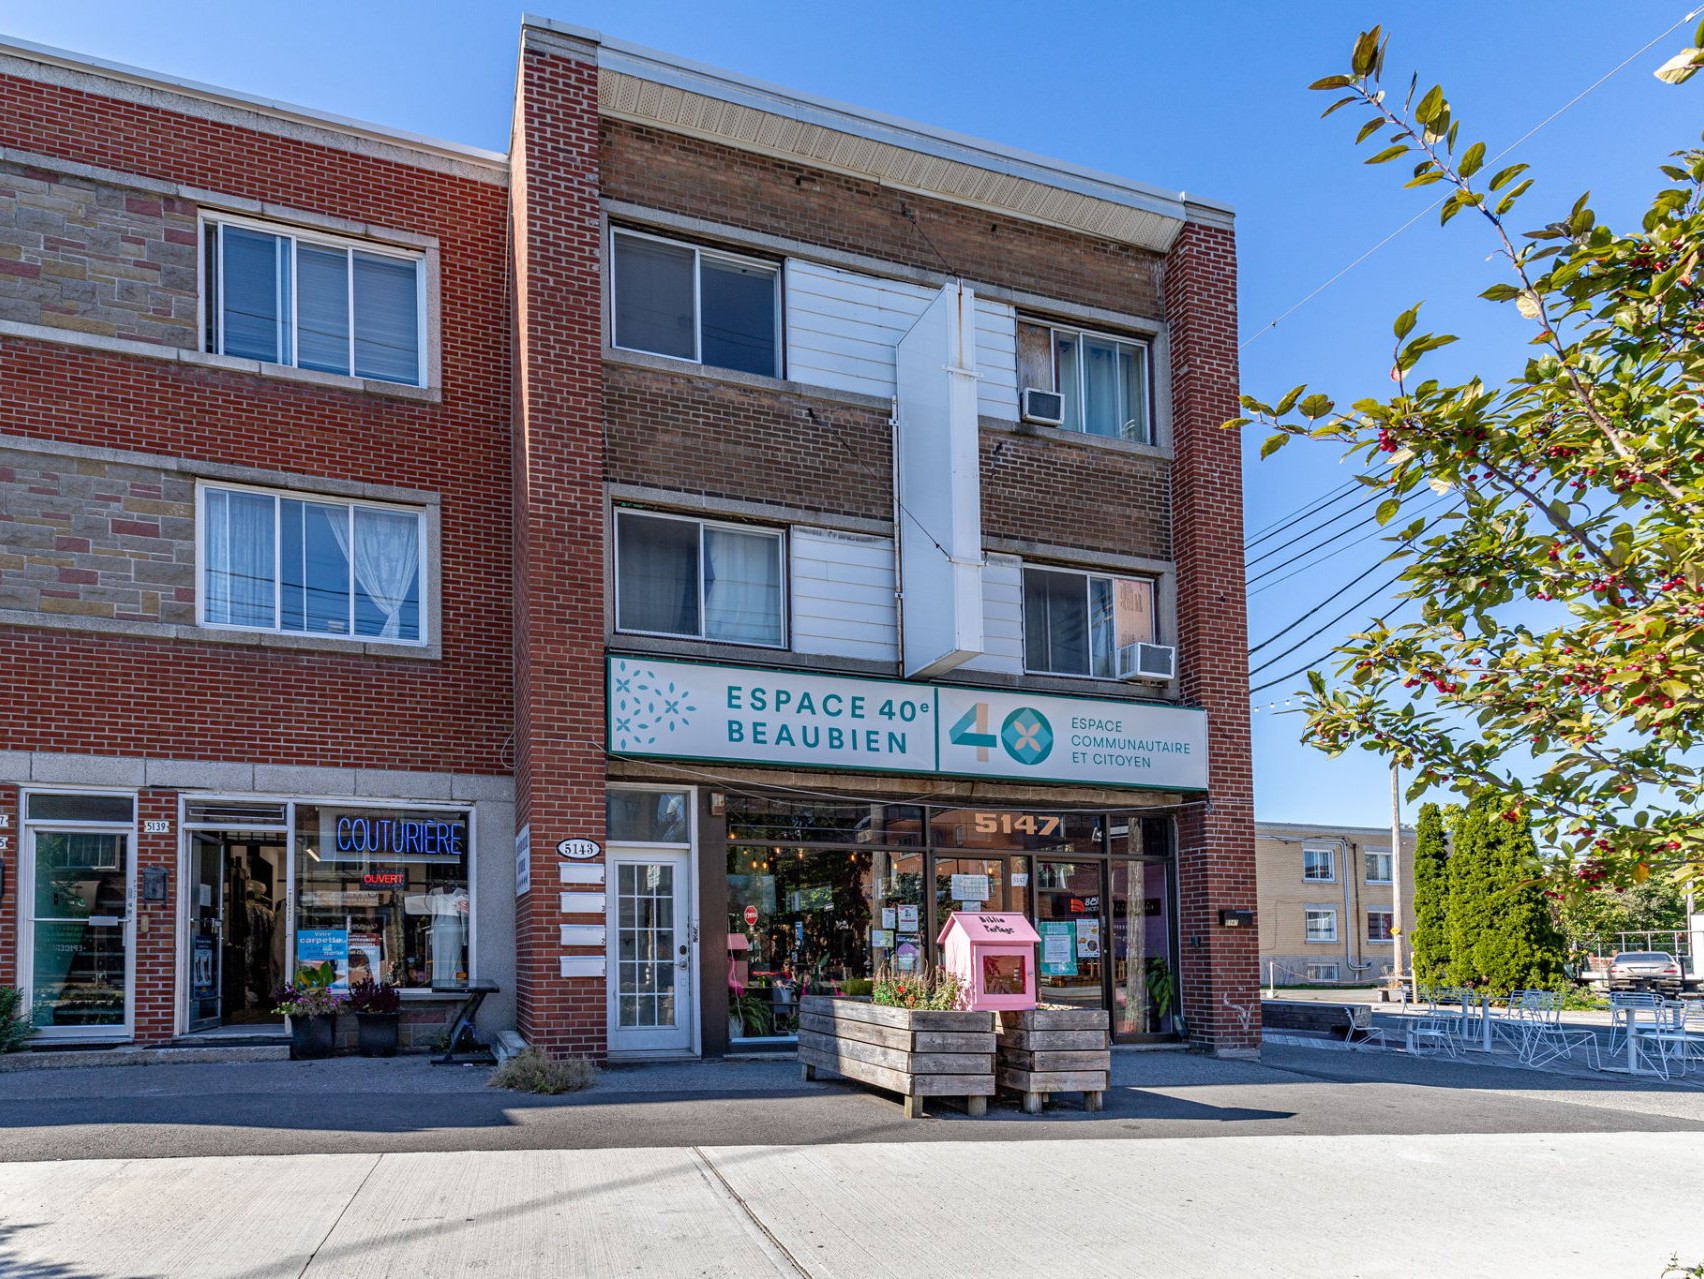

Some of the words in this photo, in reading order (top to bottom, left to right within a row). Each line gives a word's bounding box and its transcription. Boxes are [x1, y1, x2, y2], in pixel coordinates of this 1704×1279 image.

[727, 685, 865, 719] ESPACE
[1071, 717, 1122, 733] ESPACE
[727, 719, 907, 754] BEAUBIEN
[1071, 734, 1191, 754] COMMUNAUTAIRE
[1072, 752, 1087, 764] ET
[1093, 753, 1151, 768] CITOYEN
[147, 822, 166, 831] 5139
[974, 813, 1060, 836] 5147
[337, 817, 462, 855] COUTURIÈRE
[564, 843, 594, 855] 5143
[363, 874, 405, 884] OUVERT
